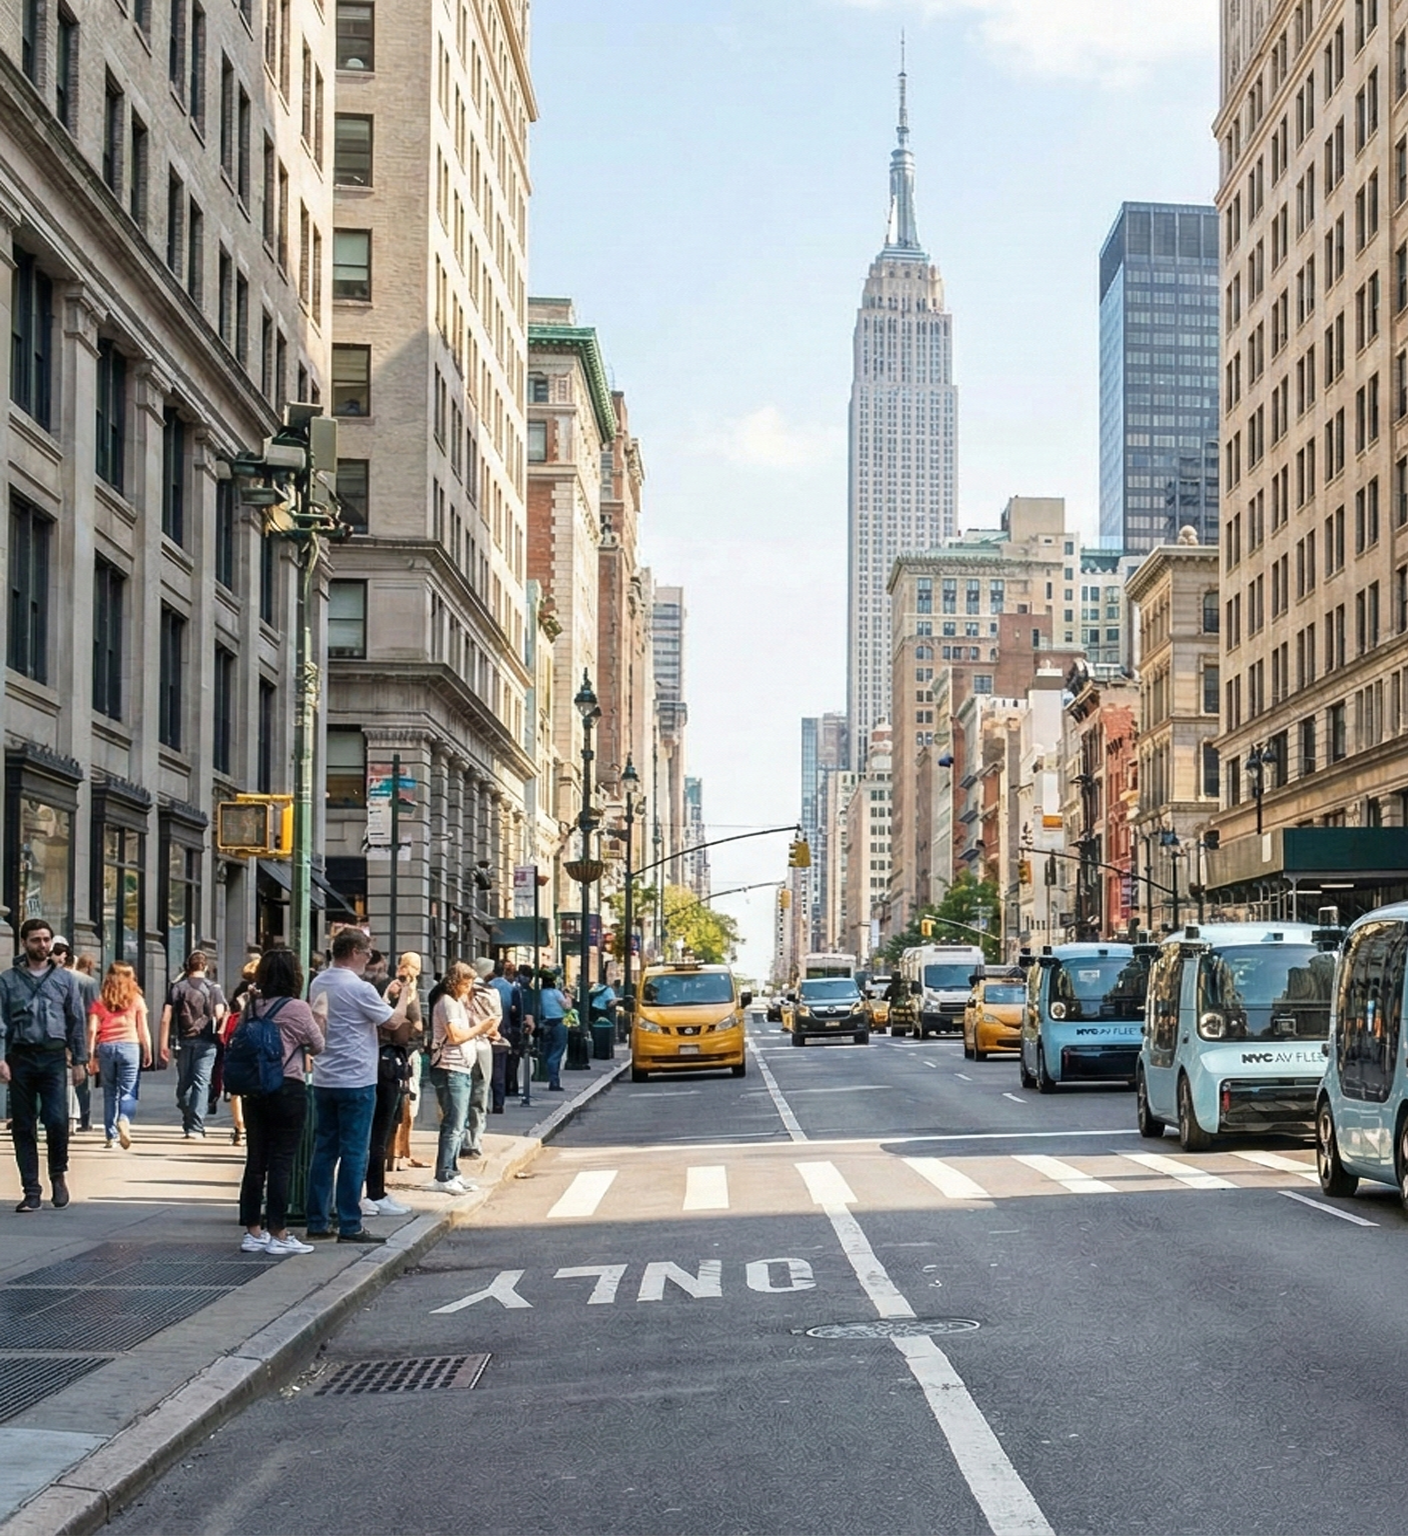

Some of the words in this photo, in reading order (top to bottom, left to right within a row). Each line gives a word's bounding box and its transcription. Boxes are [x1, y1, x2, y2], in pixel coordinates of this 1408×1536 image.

[1241, 1053, 1273, 1064] NYC
[1274, 1053, 1293, 1063] AV
[1296, 1052, 1325, 1063] FLEE
[429, 1257, 817, 1314] ONLY
